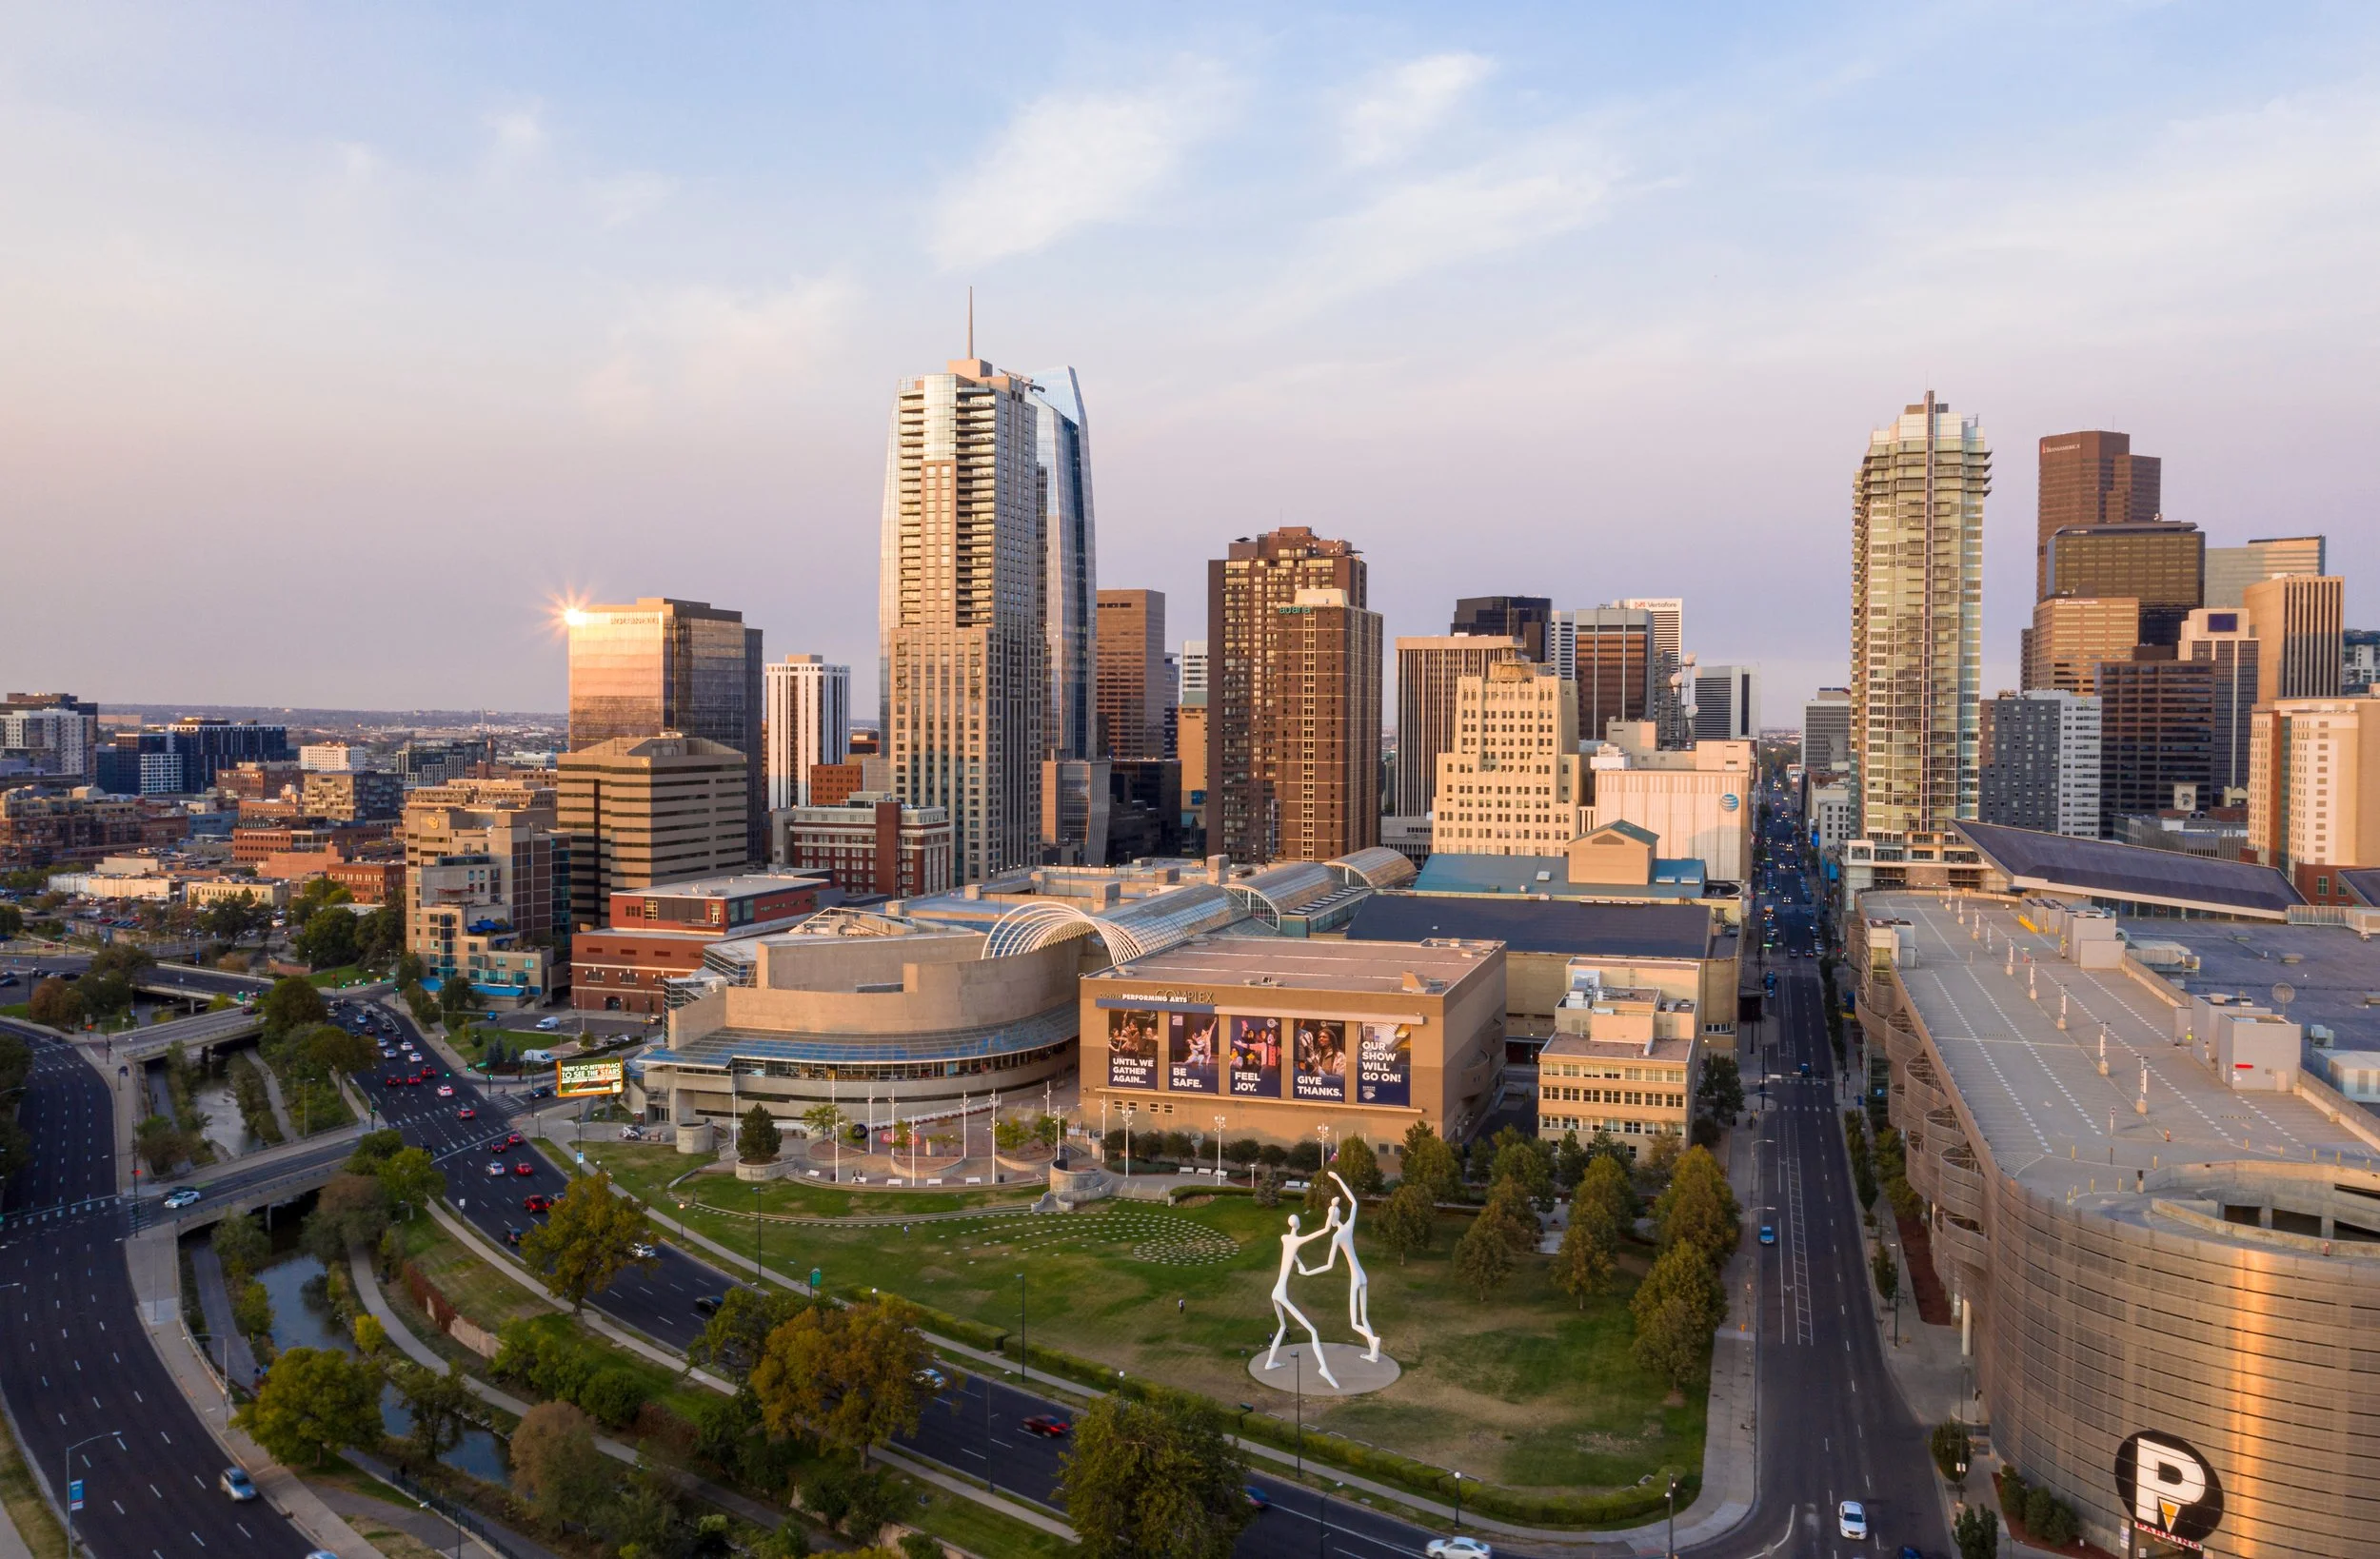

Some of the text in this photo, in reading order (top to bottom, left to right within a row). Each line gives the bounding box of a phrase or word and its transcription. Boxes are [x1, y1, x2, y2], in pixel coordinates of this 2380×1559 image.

[1121, 993, 1168, 1002] PERFORMING
[1155, 990, 1215, 1004] COMPLEX
[1362, 1040, 1386, 1051] OUR
[1362, 1051, 1397, 1062] SHOW
[1113, 1057, 1154, 1068] UNTIL WE
[1362, 1061, 1390, 1072] WILL
[600, 1068, 621, 1076] STARS
[1113, 1067, 1147, 1076] GATHER
[1173, 1067, 1187, 1076] BE
[1235, 1072, 1260, 1082] FEEL
[1113, 1075, 1147, 1084] AGAIN...
[1173, 1078, 1202, 1088] SAFE.
[1297, 1076, 1322, 1085] GIVE
[1362, 1072, 1401, 1083] GO ON!
[1235, 1082, 1257, 1092] JOY.
[1297, 1085, 1342, 1096] THANKS.
[2135, 1437, 2206, 1525] P
[2135, 1523, 2202, 1550] PARKING
